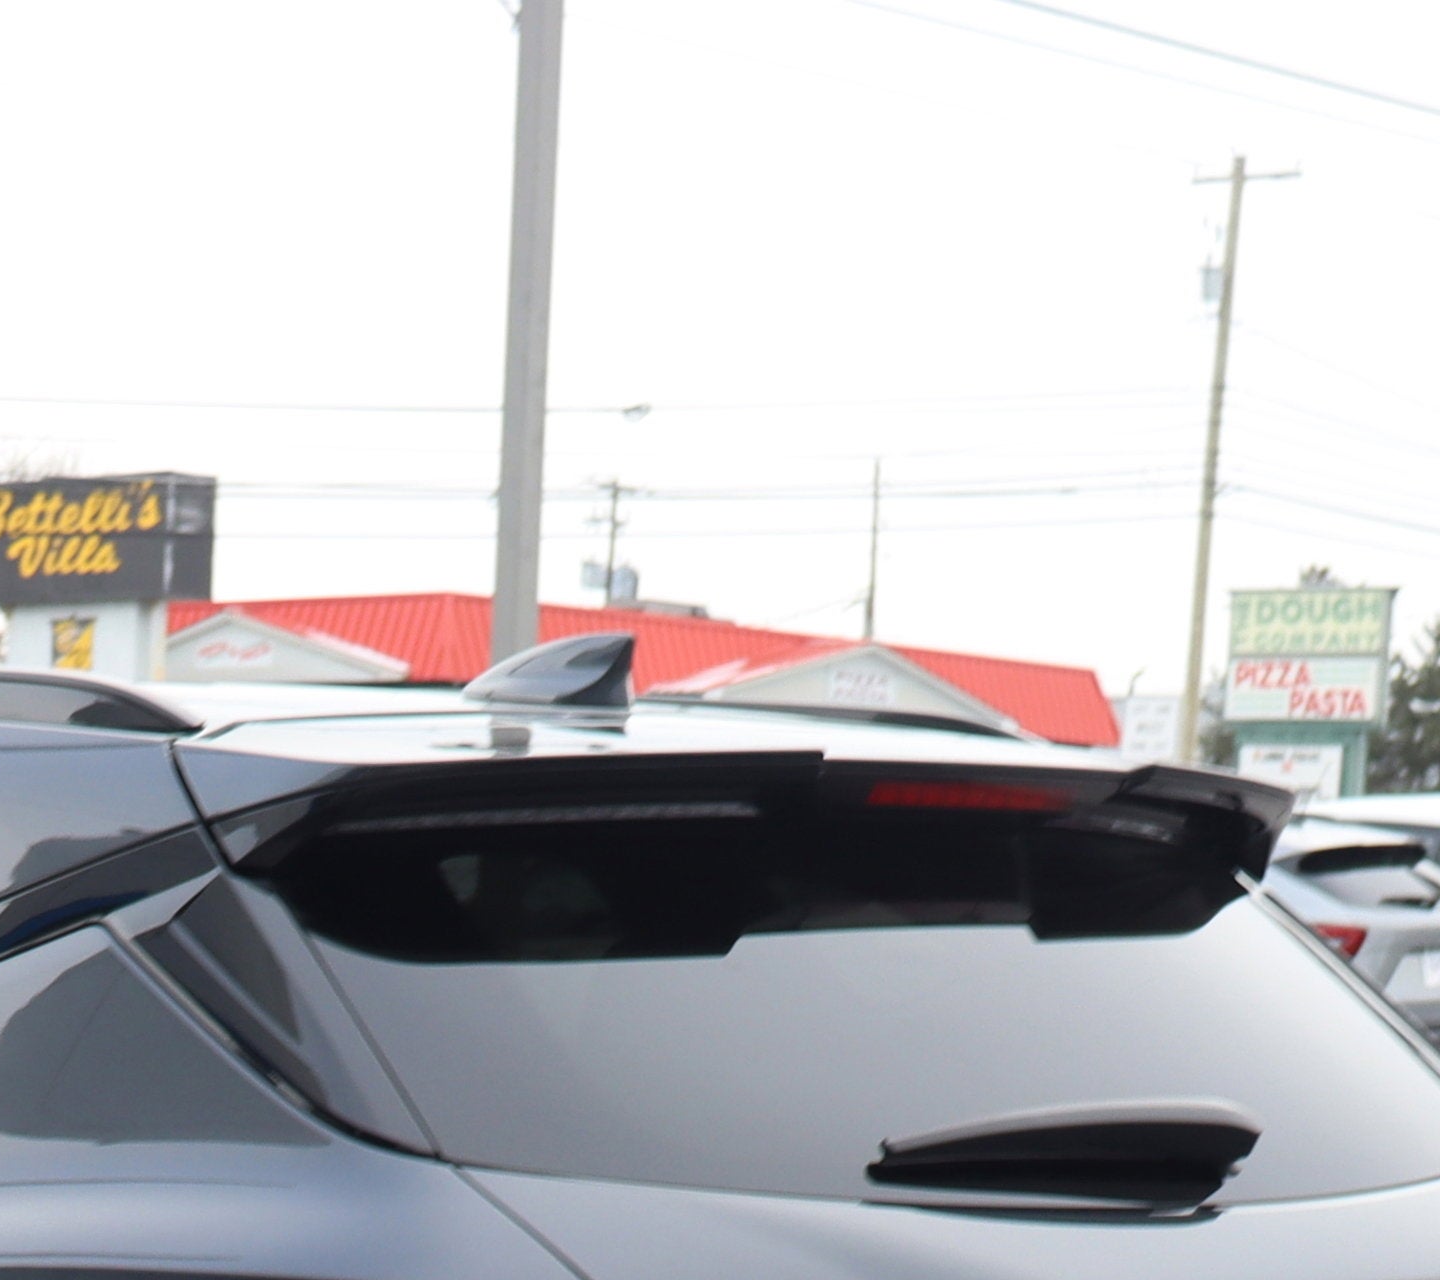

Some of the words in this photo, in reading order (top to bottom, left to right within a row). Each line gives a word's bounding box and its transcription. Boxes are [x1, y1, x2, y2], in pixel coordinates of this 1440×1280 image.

[6, 533, 120, 578] Villa
[1256, 598, 1383, 626] DOUGH
[1235, 661, 1311, 688] PIZZA
[1288, 687, 1368, 718] PASTA
